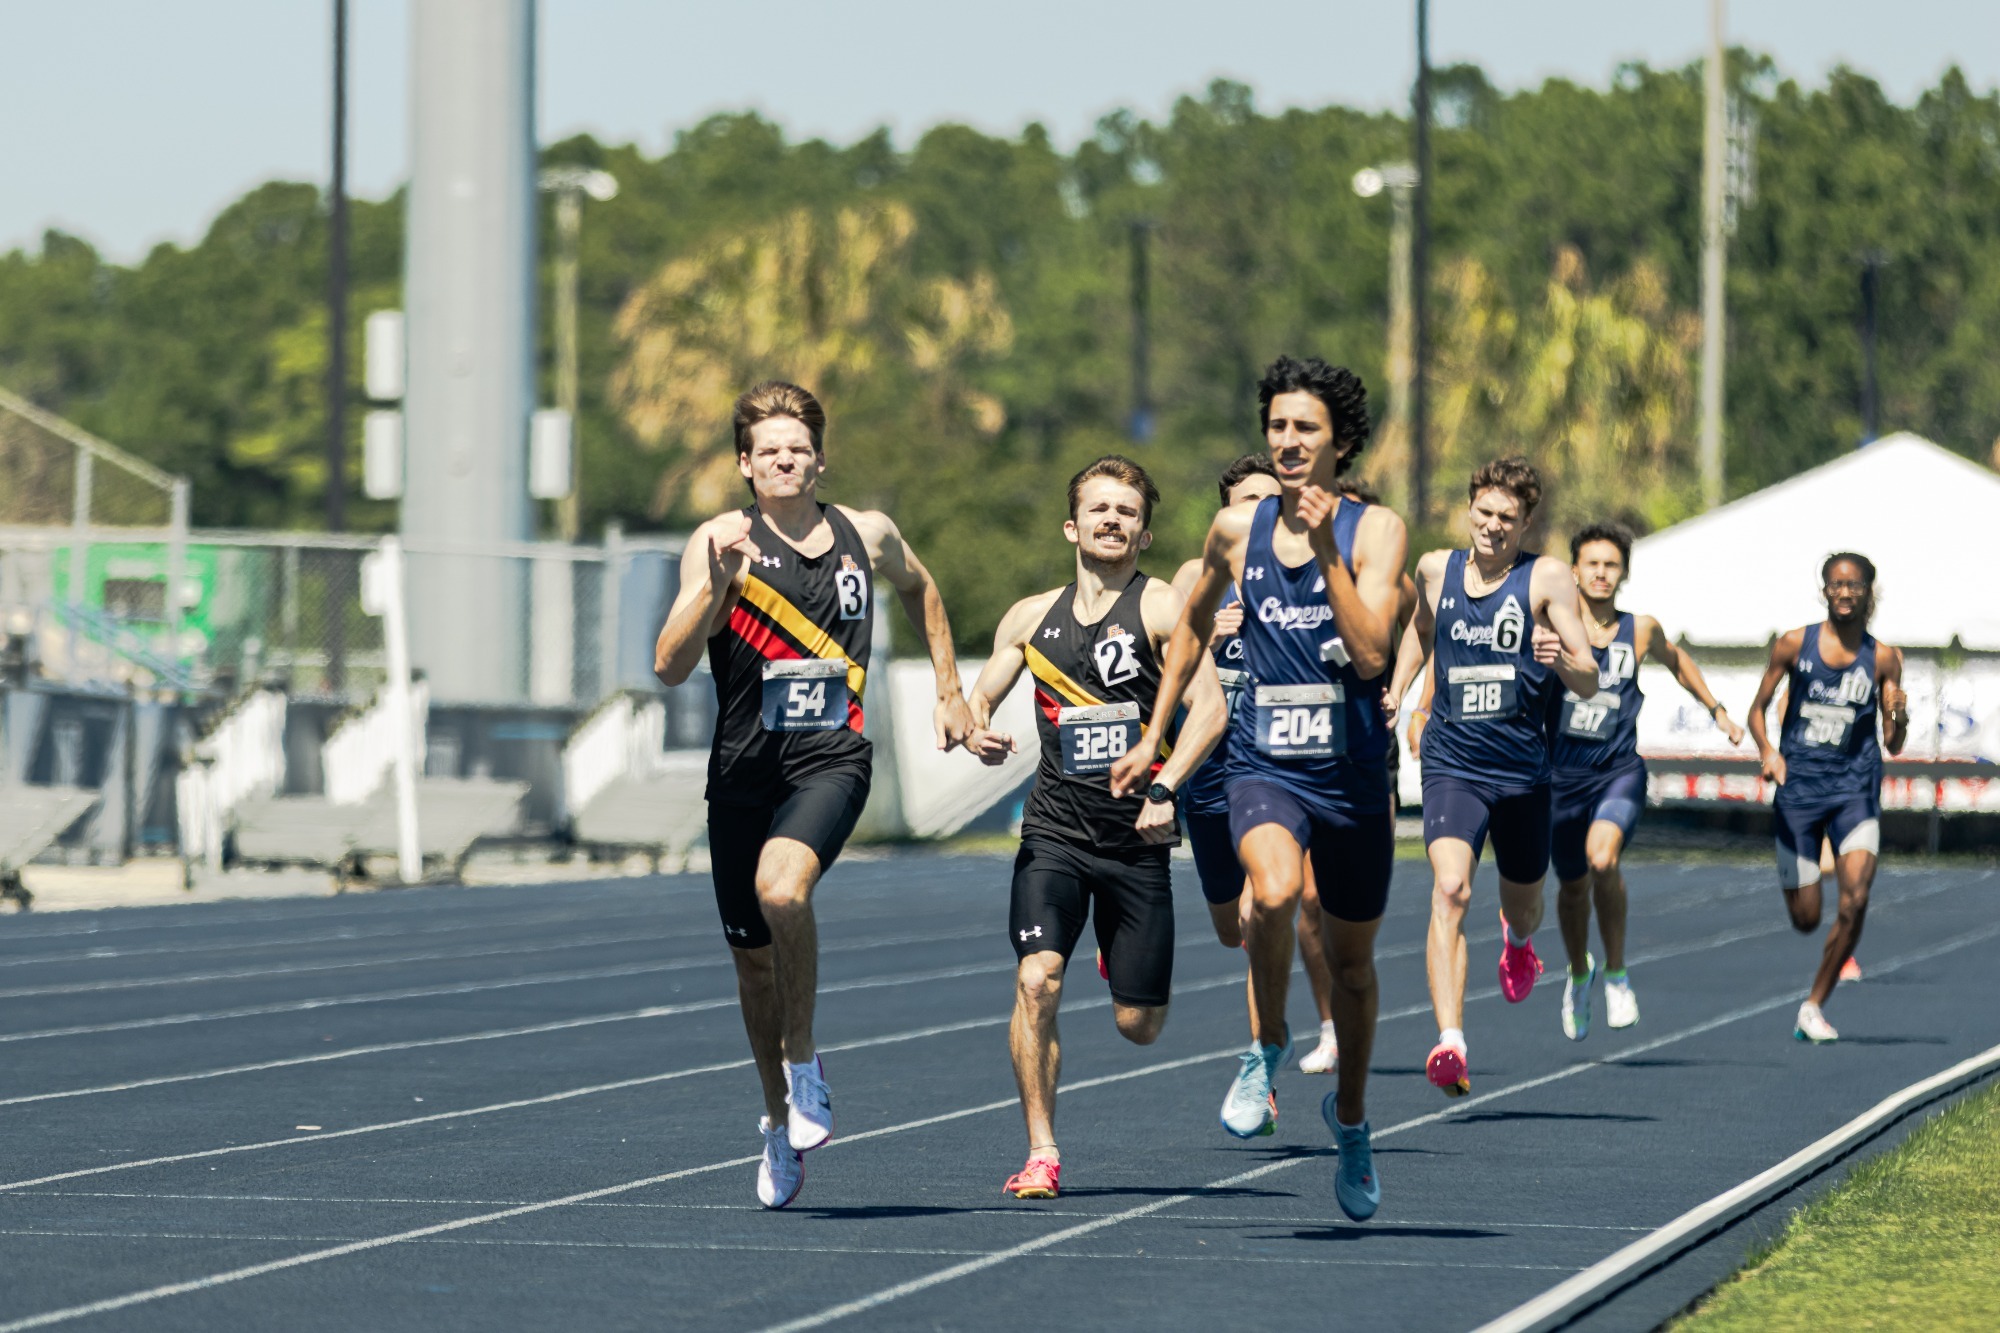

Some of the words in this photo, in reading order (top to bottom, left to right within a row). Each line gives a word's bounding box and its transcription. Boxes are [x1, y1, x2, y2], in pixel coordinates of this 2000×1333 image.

[842, 574, 863, 617] 3
[1258, 596, 1334, 630] Ospreys
[1496, 618, 1518, 651] 6
[1100, 640, 1131, 682] 2
[1613, 648, 1627, 674] 7
[786, 681, 826, 718] 54
[1462, 682, 1502, 713] 218
[1268, 707, 1333, 746] 204
[1569, 702, 1608, 732] 217
[1073, 724, 1128, 761] 328
